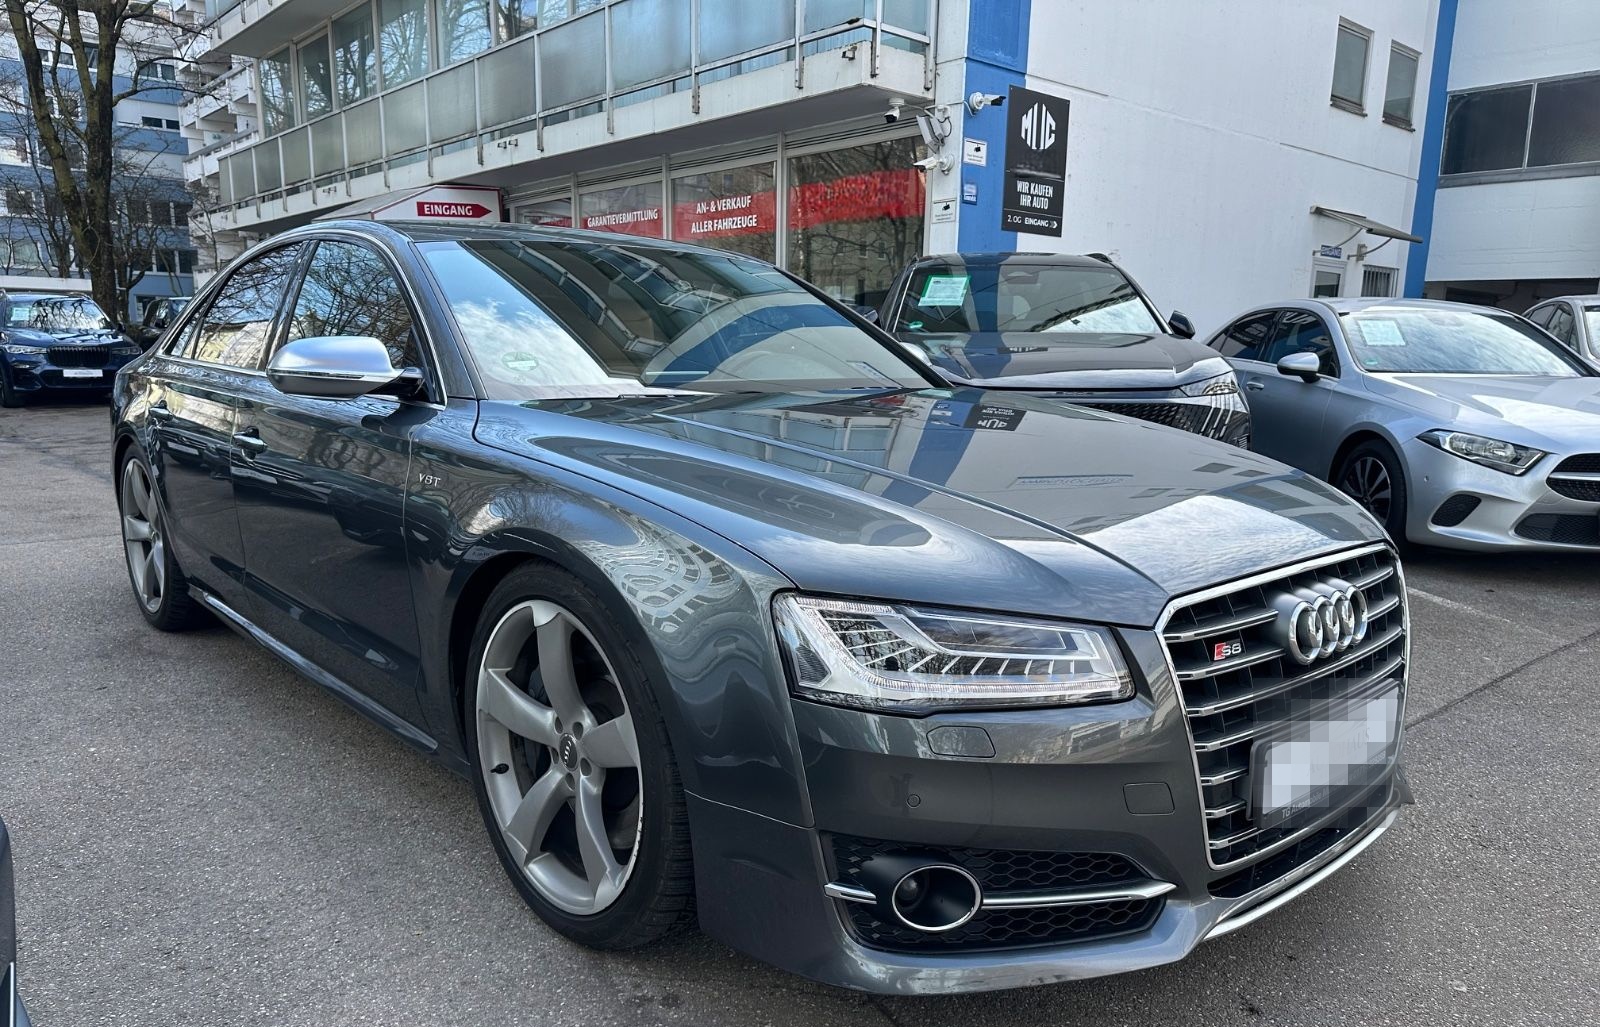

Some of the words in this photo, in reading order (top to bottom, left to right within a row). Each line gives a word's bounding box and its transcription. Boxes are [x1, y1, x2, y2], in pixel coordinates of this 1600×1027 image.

[1017, 180, 1030, 194] WIR
[1030, 182, 1054, 198] KAUFEN
[424, 204, 473, 216] EINGANG
[696, 201, 709, 215] AN-
[710, 200, 716, 213] &
[717, 195, 751, 212] VERKAUF
[1020, 194, 1031, 207] IHR
[1032, 196, 1049, 210] AUTO
[587, 208, 658, 228] GARANTIEVERMITTLUNG
[691, 220, 713, 234] ALLER
[713, 214, 757, 231] FAHRZEUGE
[1013, 215, 1022, 224] OG
[1024, 217, 1049, 228] EINGANG
[419, 472, 442, 488] V8T
[1222, 642, 1242, 656] S8
